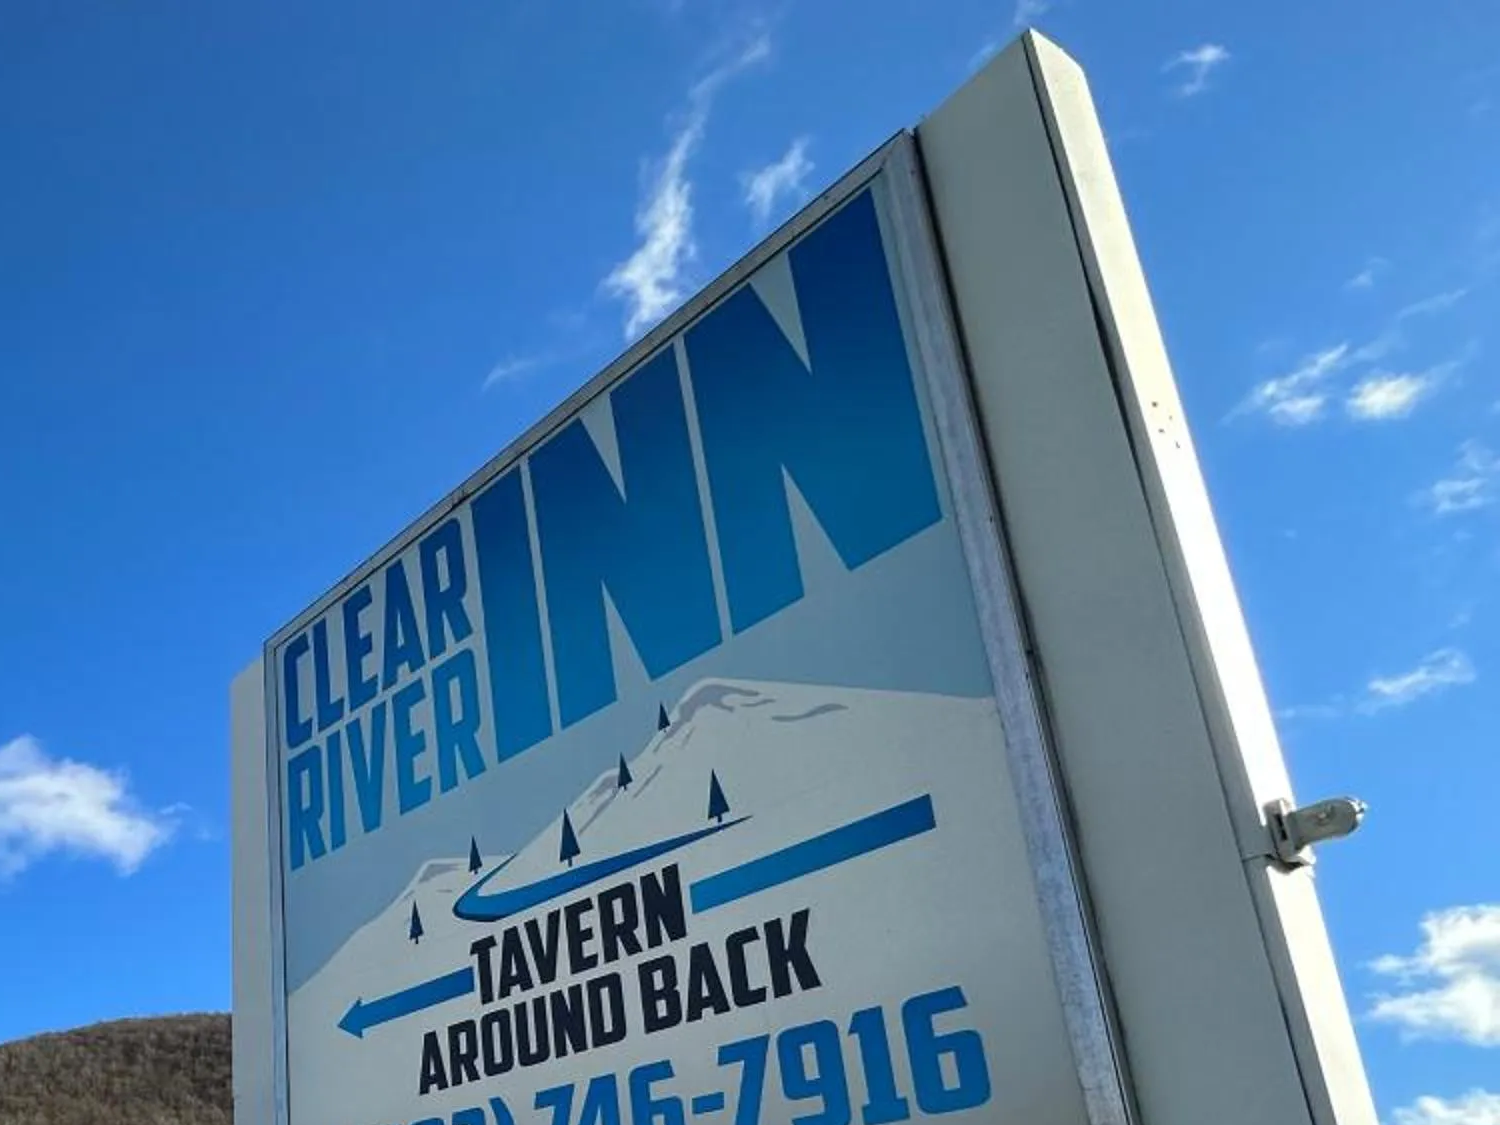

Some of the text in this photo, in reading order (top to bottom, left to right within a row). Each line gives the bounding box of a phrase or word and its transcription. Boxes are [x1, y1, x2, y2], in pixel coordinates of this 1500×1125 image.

[470, 187, 942, 764] INN
[285, 516, 474, 750] CLEAR
[287, 648, 486, 868] RIVER
[419, 908, 822, 1094] AROUND BACK
[470, 864, 687, 1004] TAVERN
